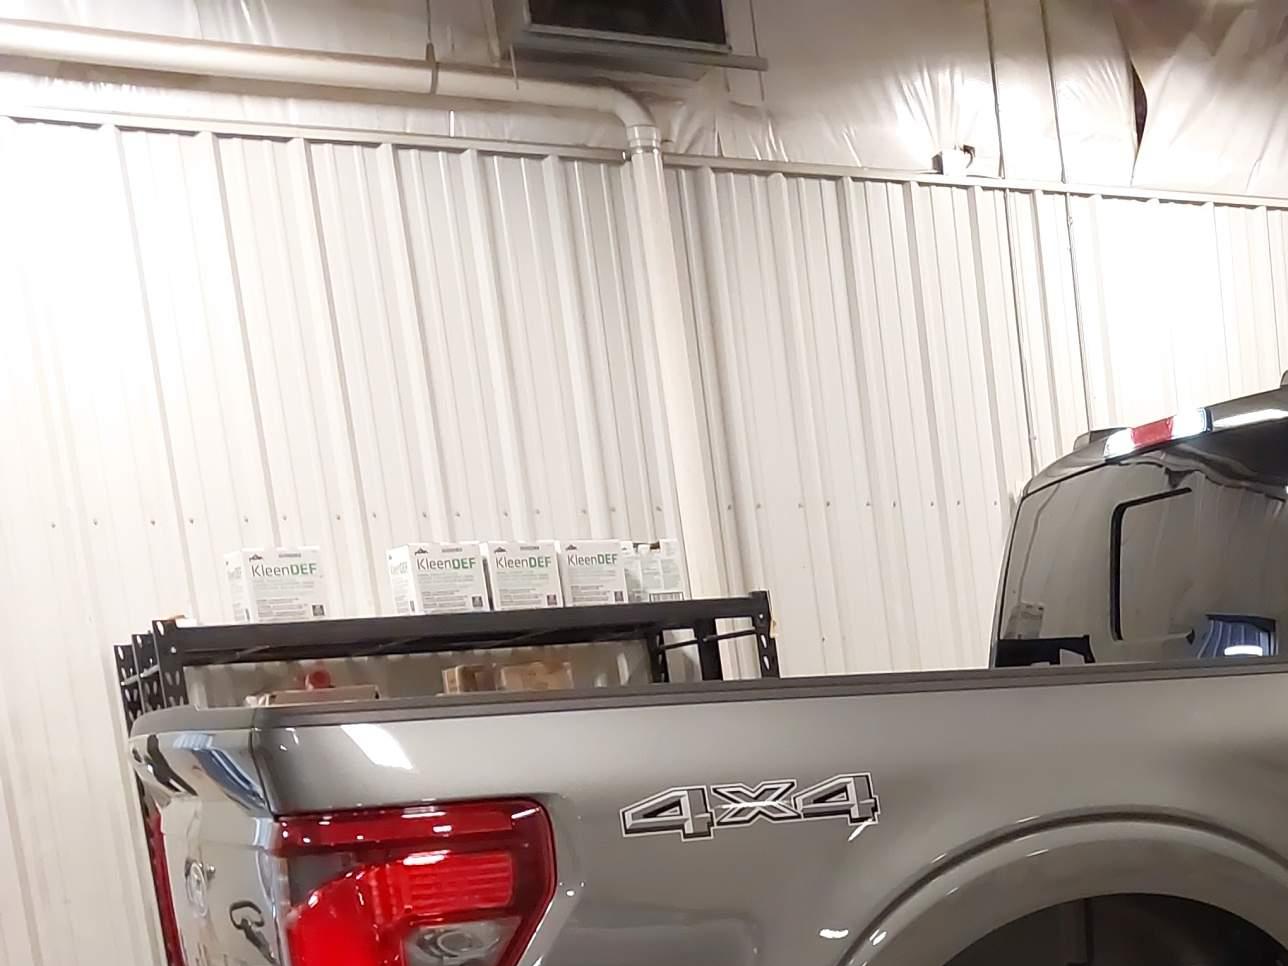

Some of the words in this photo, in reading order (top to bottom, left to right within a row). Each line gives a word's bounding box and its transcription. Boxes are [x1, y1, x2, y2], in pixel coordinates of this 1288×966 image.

[417, 557, 476, 570] KleenDEF
[496, 556, 552, 569] KleenDEF
[568, 553, 618, 566] KleenDEF
[251, 562, 317, 577] KleenDEF
